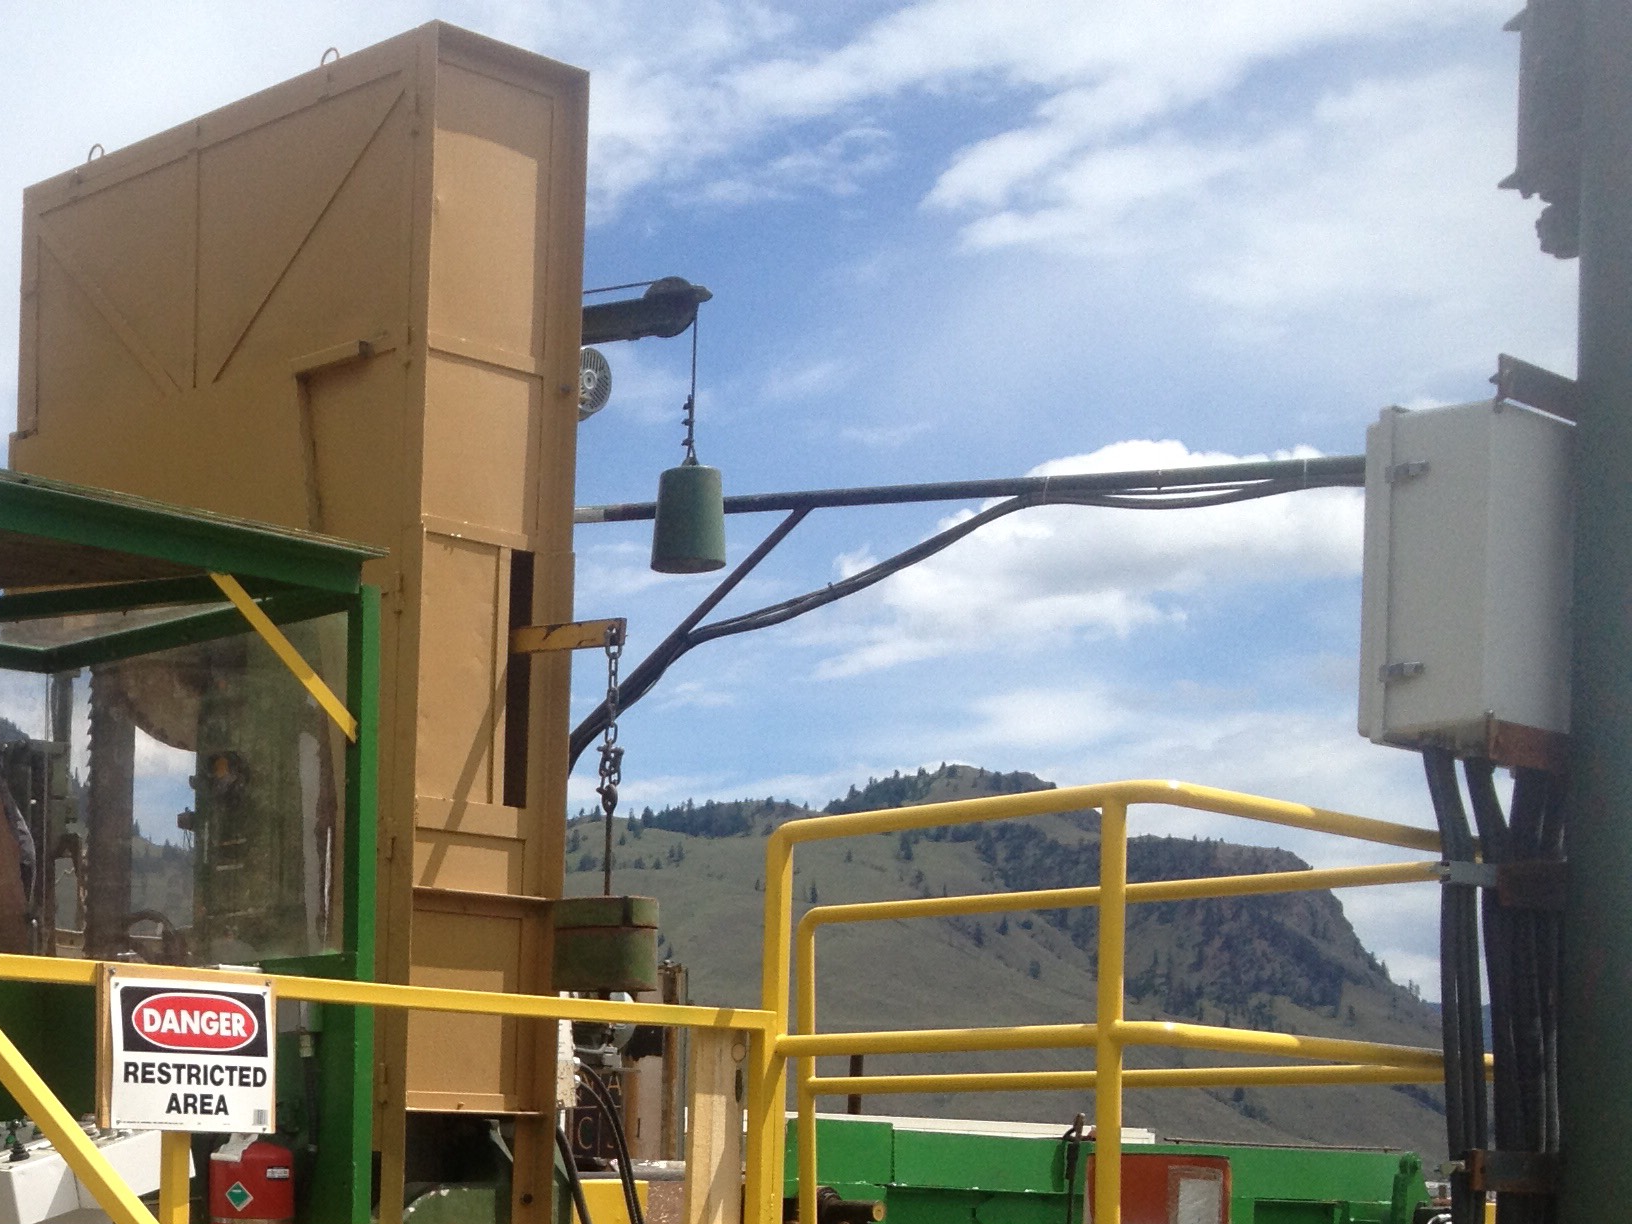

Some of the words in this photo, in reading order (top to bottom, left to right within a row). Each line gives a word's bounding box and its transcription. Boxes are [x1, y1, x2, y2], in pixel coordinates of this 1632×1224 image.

[143, 1008, 247, 1037] DANGER
[124, 1061, 267, 1087] RESTRICTED
[166, 1093, 229, 1116] AREA
